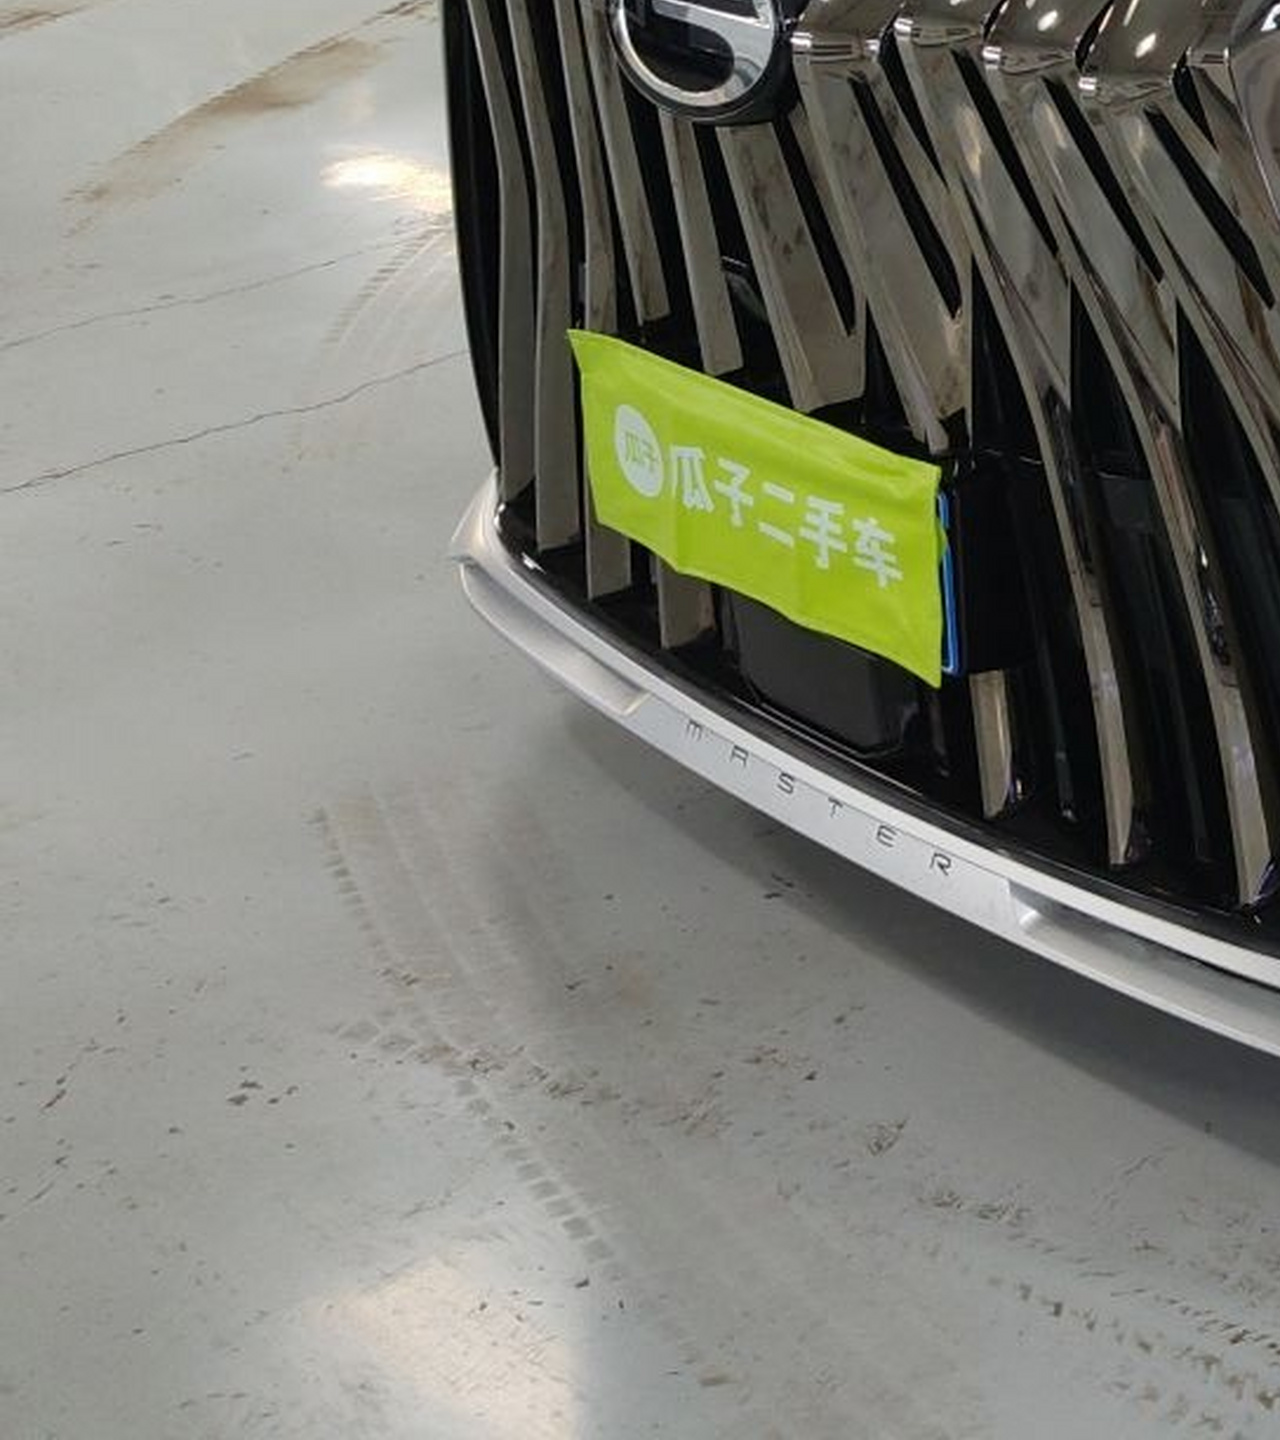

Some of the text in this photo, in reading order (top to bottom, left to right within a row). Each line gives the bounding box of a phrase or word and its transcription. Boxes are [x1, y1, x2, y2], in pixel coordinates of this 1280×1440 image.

[670, 445, 905, 589] 瓜子二手车
